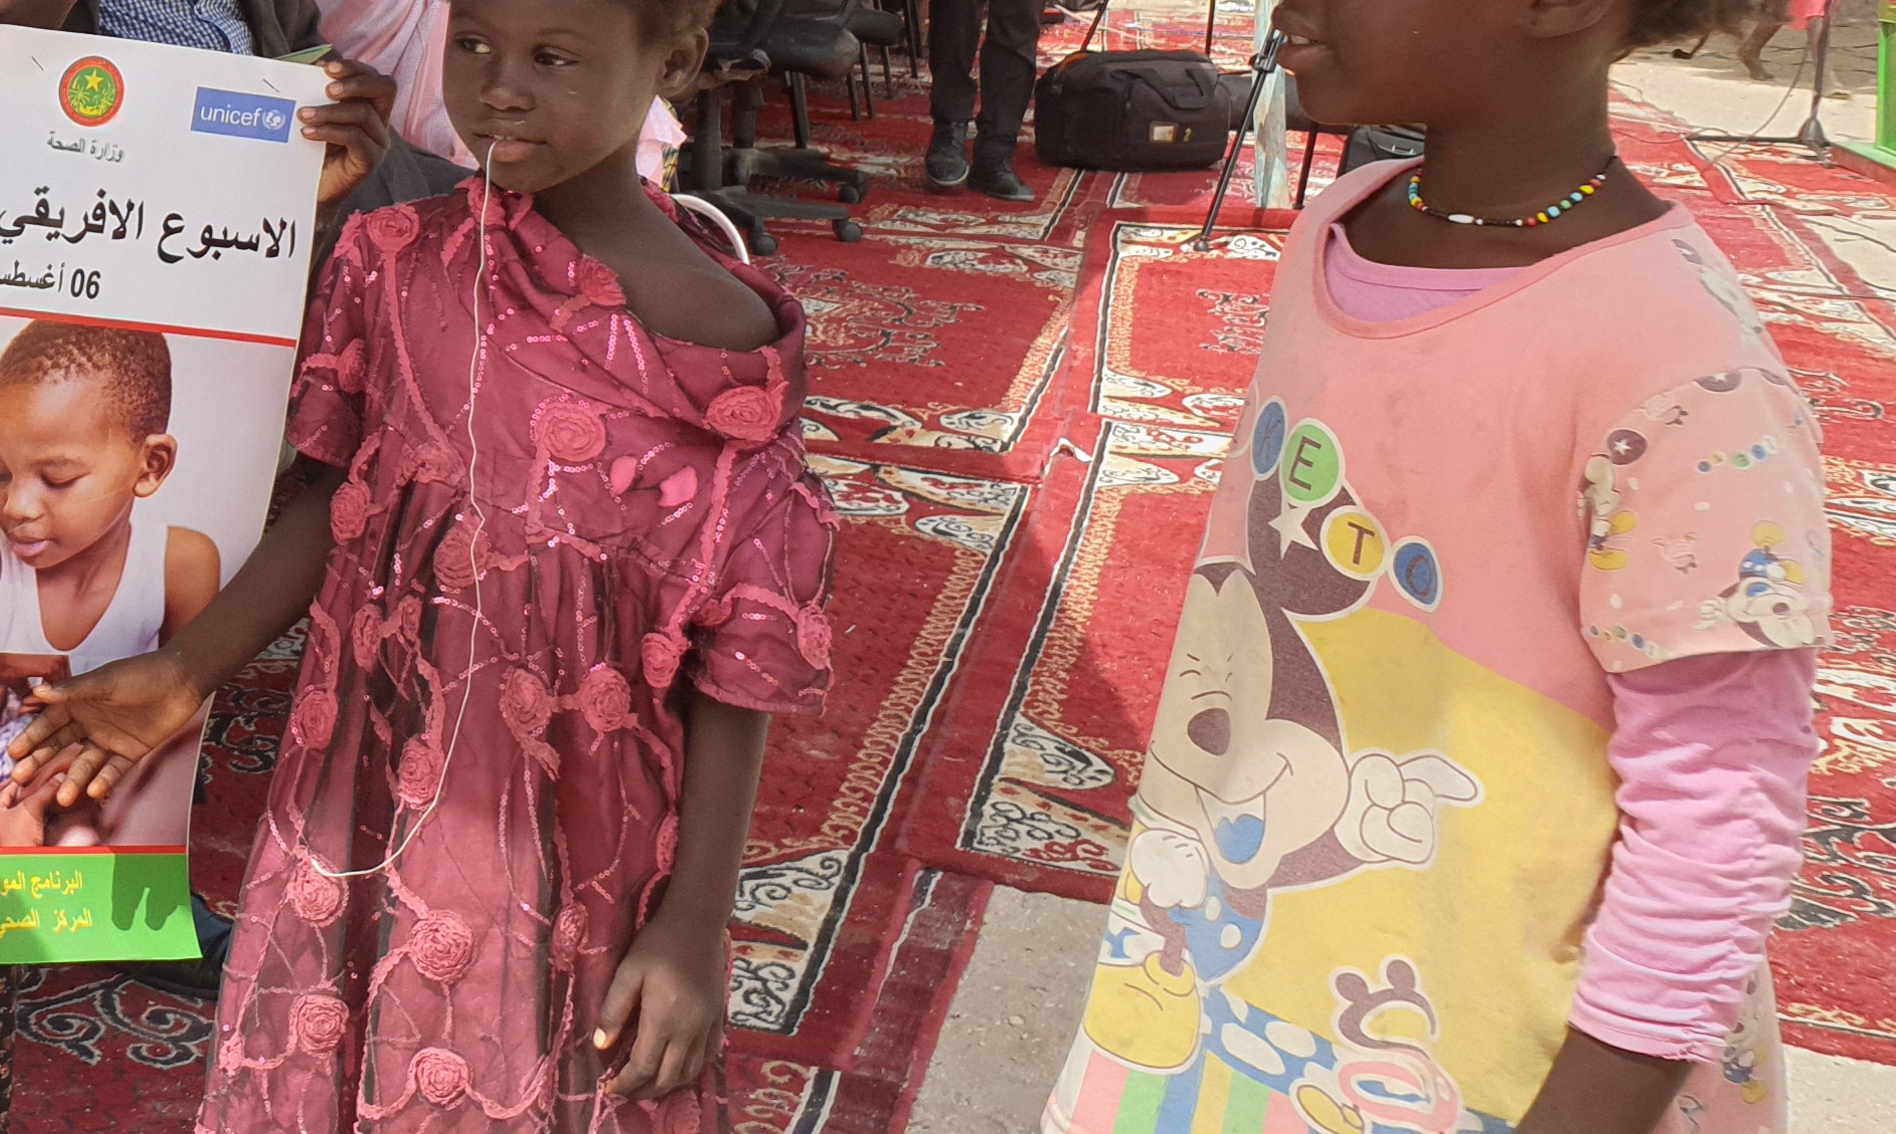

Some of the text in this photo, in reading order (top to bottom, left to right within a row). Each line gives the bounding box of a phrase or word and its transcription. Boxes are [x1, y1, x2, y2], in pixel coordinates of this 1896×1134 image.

[200, 104, 262, 128] unicef
[47, 130, 125, 163] وزارة الصحة
[157, 212, 296, 264] الاسبوع
[70, 268, 102, 299] 06
[30, 869, 83, 901] البرنامج
[52, 906, 93, 935] المركز
